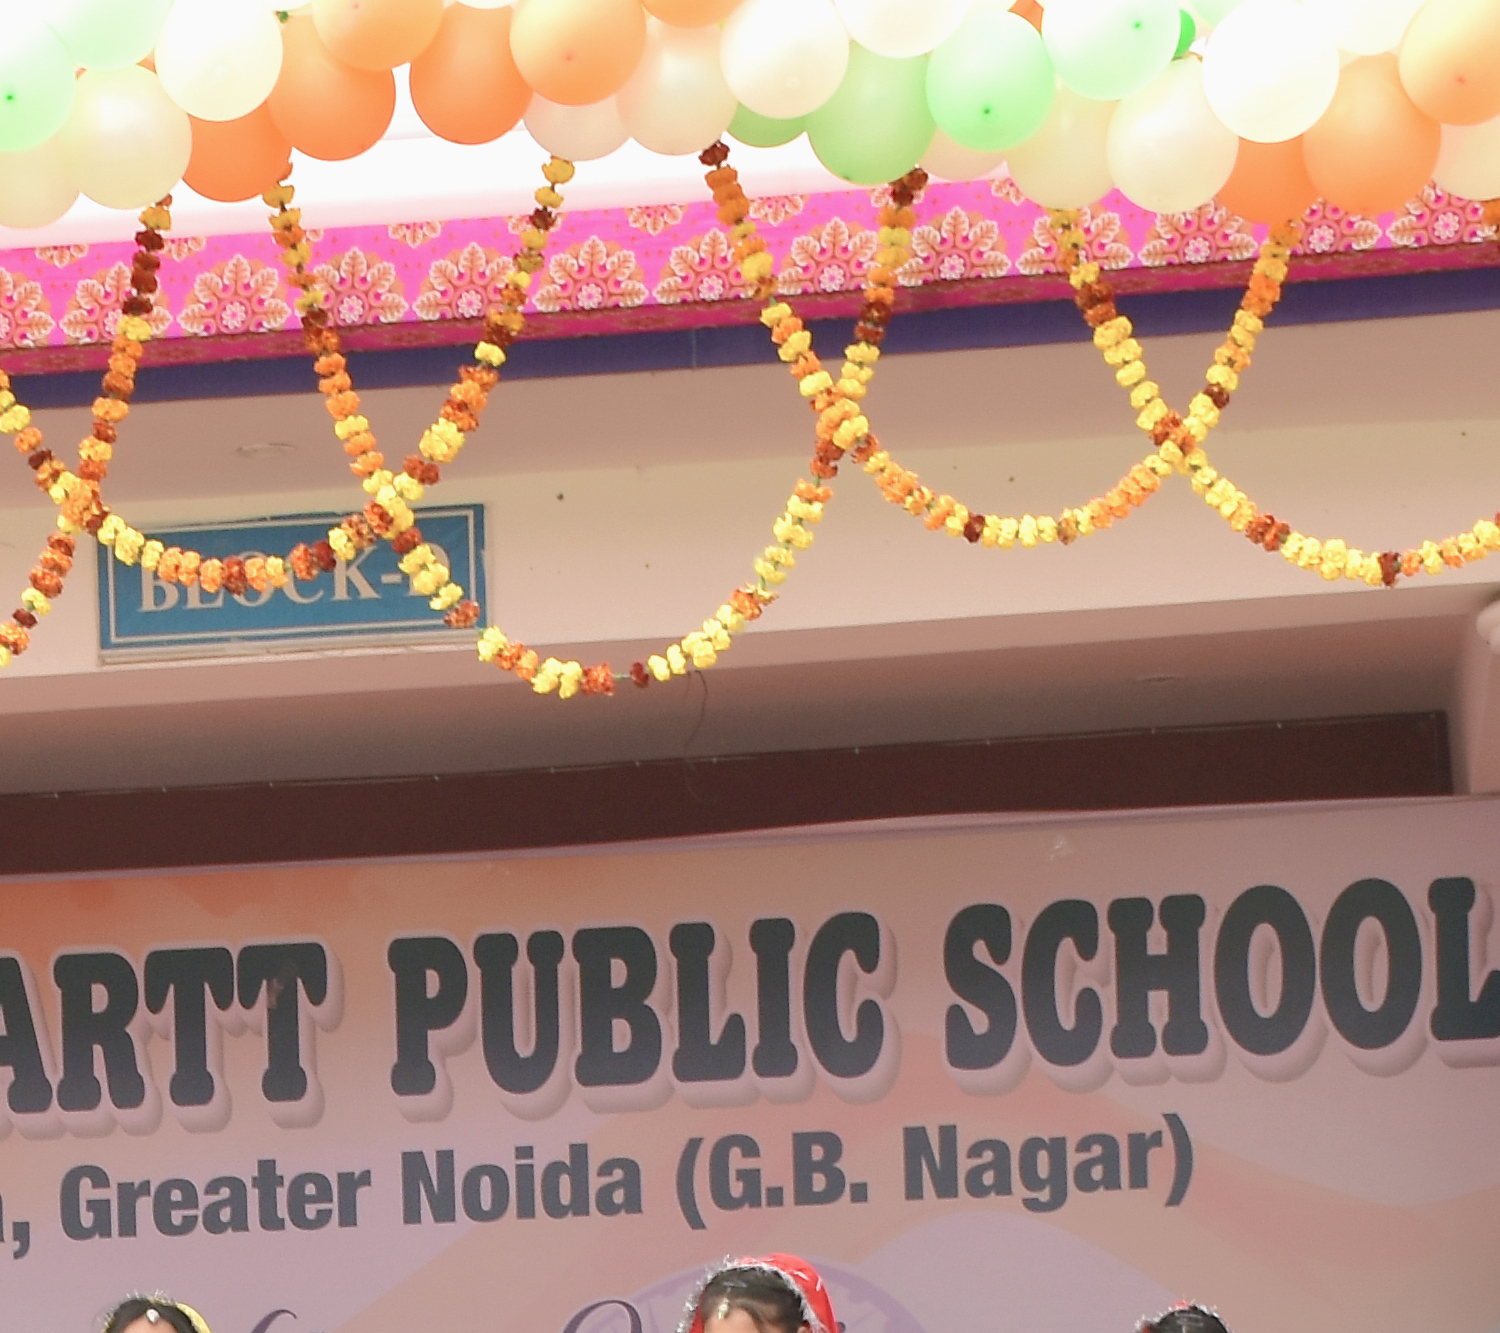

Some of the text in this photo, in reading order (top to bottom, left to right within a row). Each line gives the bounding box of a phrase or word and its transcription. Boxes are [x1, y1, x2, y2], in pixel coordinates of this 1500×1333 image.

[387, 911, 885, 1097] PUBLIC
[60, 1158, 373, 1241] Greater
[401, 1143, 644, 1225] Noida
[674, 1130, 869, 1231] (G.B.
[903, 1111, 1195, 1213] Nagar)
